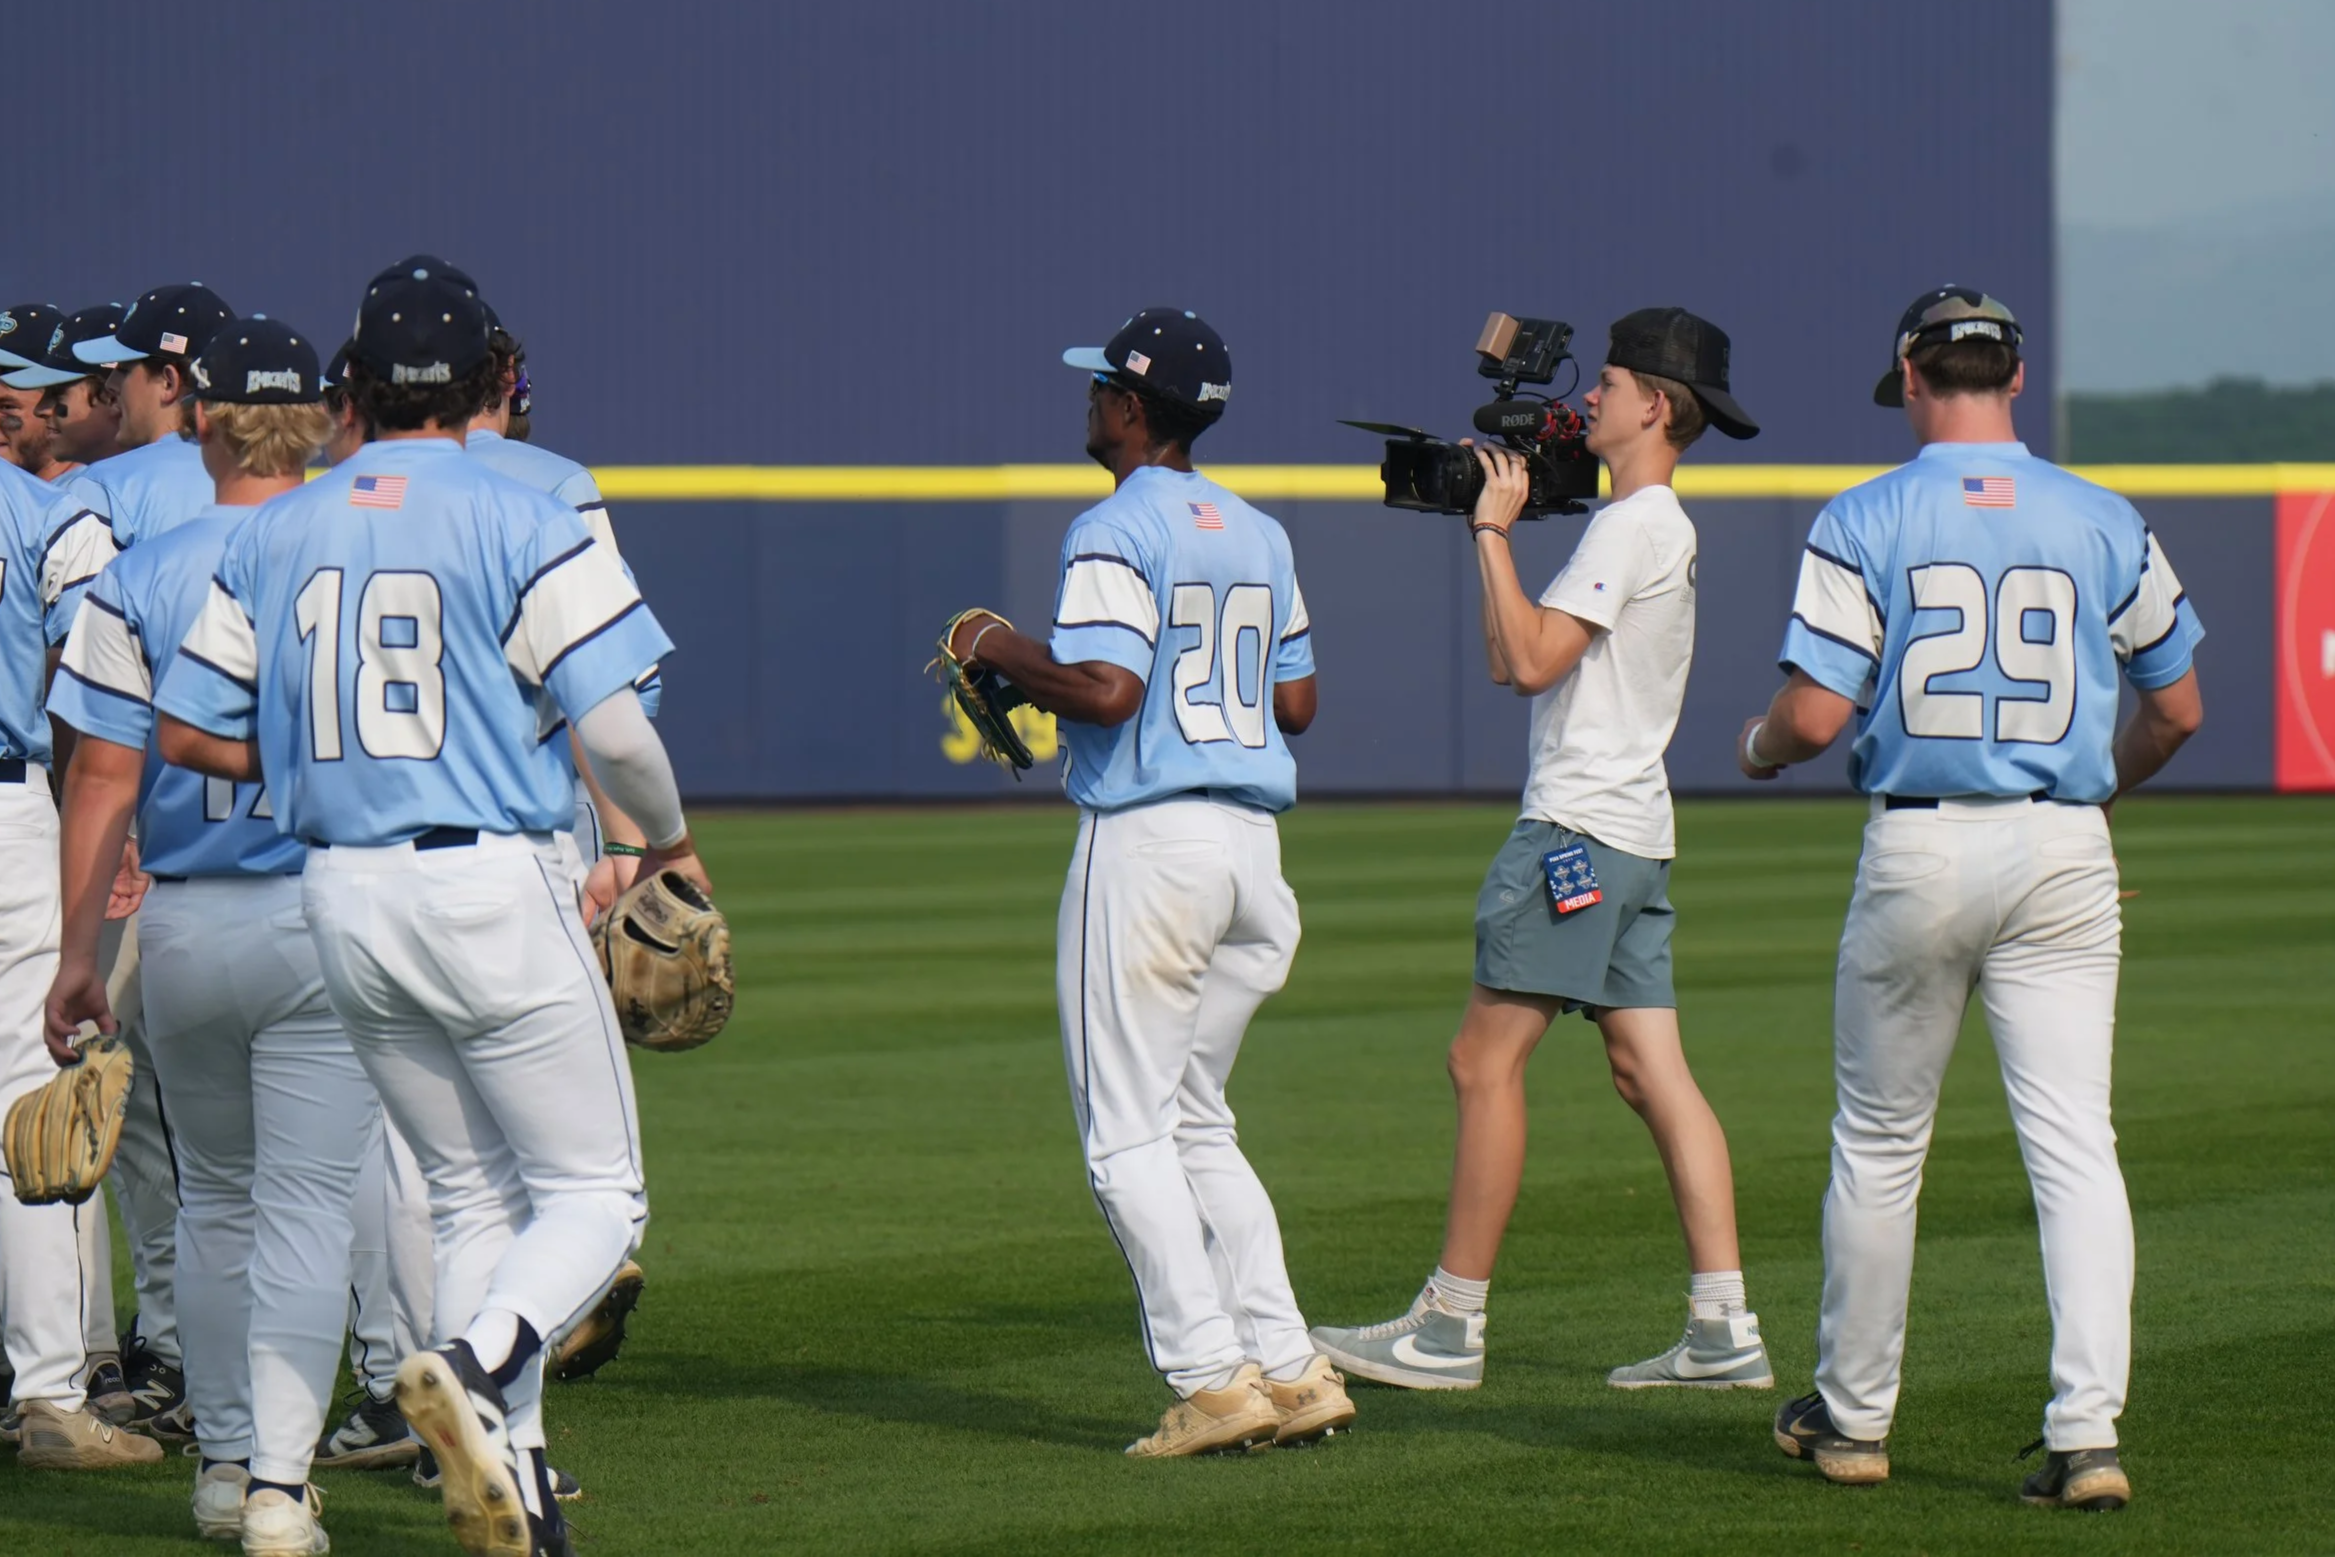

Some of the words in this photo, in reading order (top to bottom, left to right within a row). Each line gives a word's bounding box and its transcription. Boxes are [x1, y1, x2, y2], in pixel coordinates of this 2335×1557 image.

[294, 566, 447, 762] 18
[1169, 582, 1273, 749] 20
[1898, 561, 2077, 744] 29
[1565, 893, 1596, 910] MEDIA
